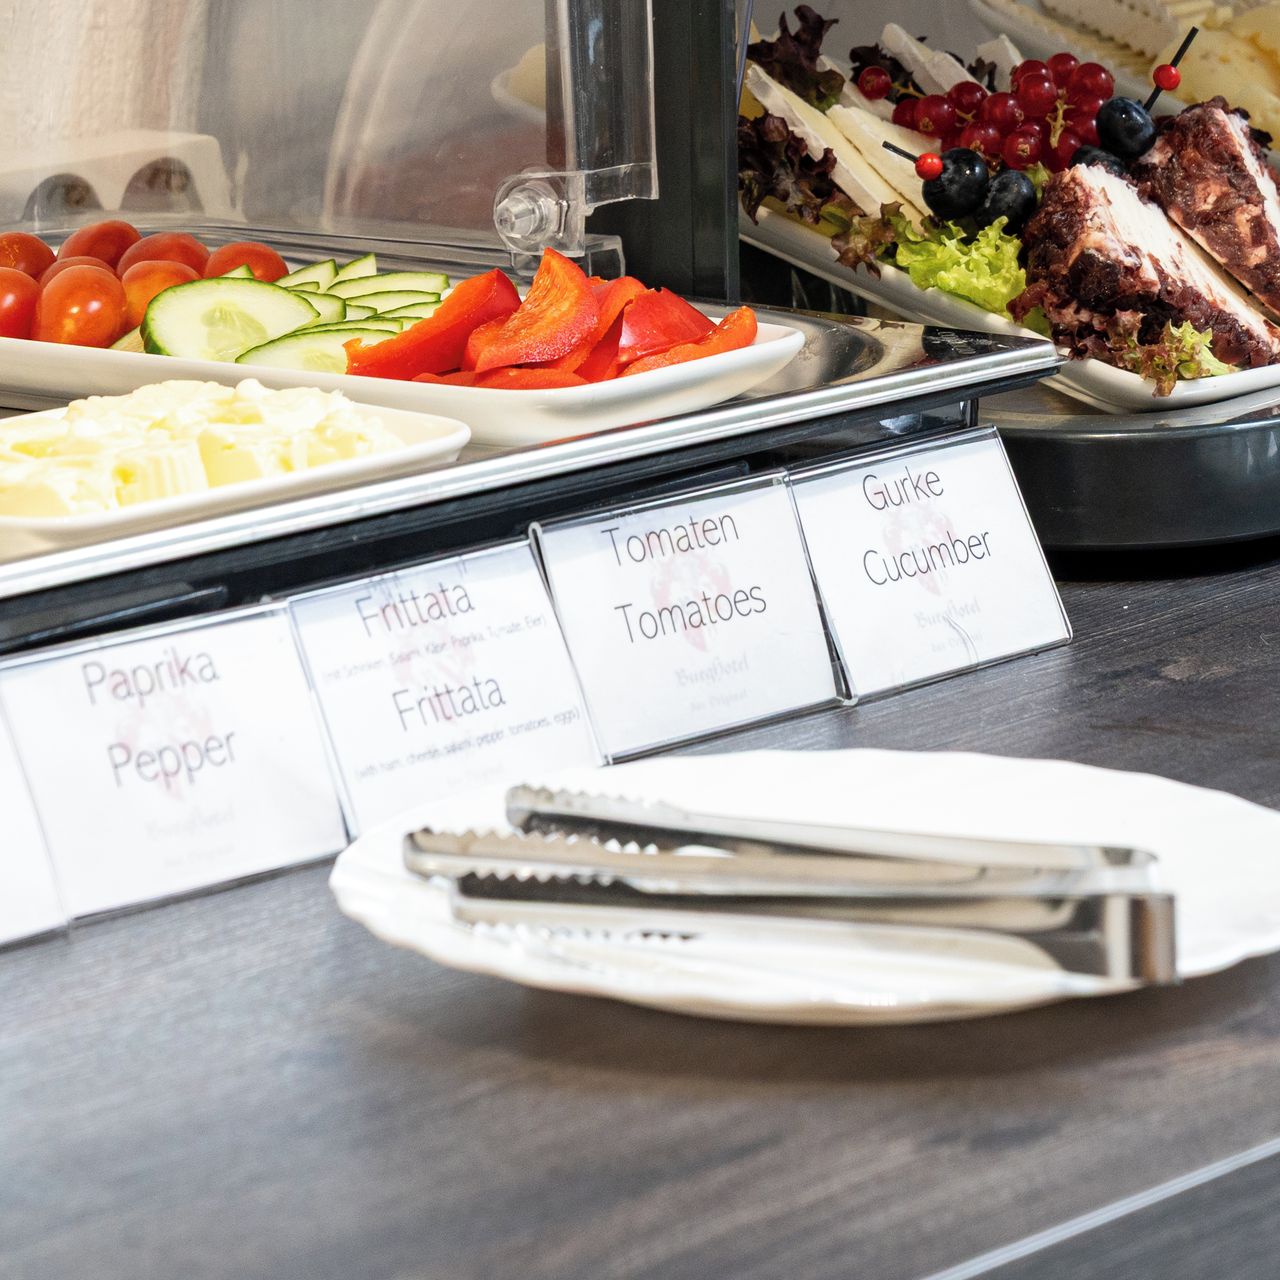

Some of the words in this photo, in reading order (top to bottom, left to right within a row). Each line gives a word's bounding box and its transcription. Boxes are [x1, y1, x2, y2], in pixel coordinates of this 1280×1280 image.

[861, 465, 945, 512] Gurke
[601, 513, 740, 568] Tomaten
[863, 529, 993, 587] Cucumber
[354, 581, 476, 639] Frittata
[614, 584, 767, 644] Tomatoes
[81, 646, 220, 710] Paprika
[392, 673, 507, 732] Frittata
[107, 730, 236, 789] Pepper
